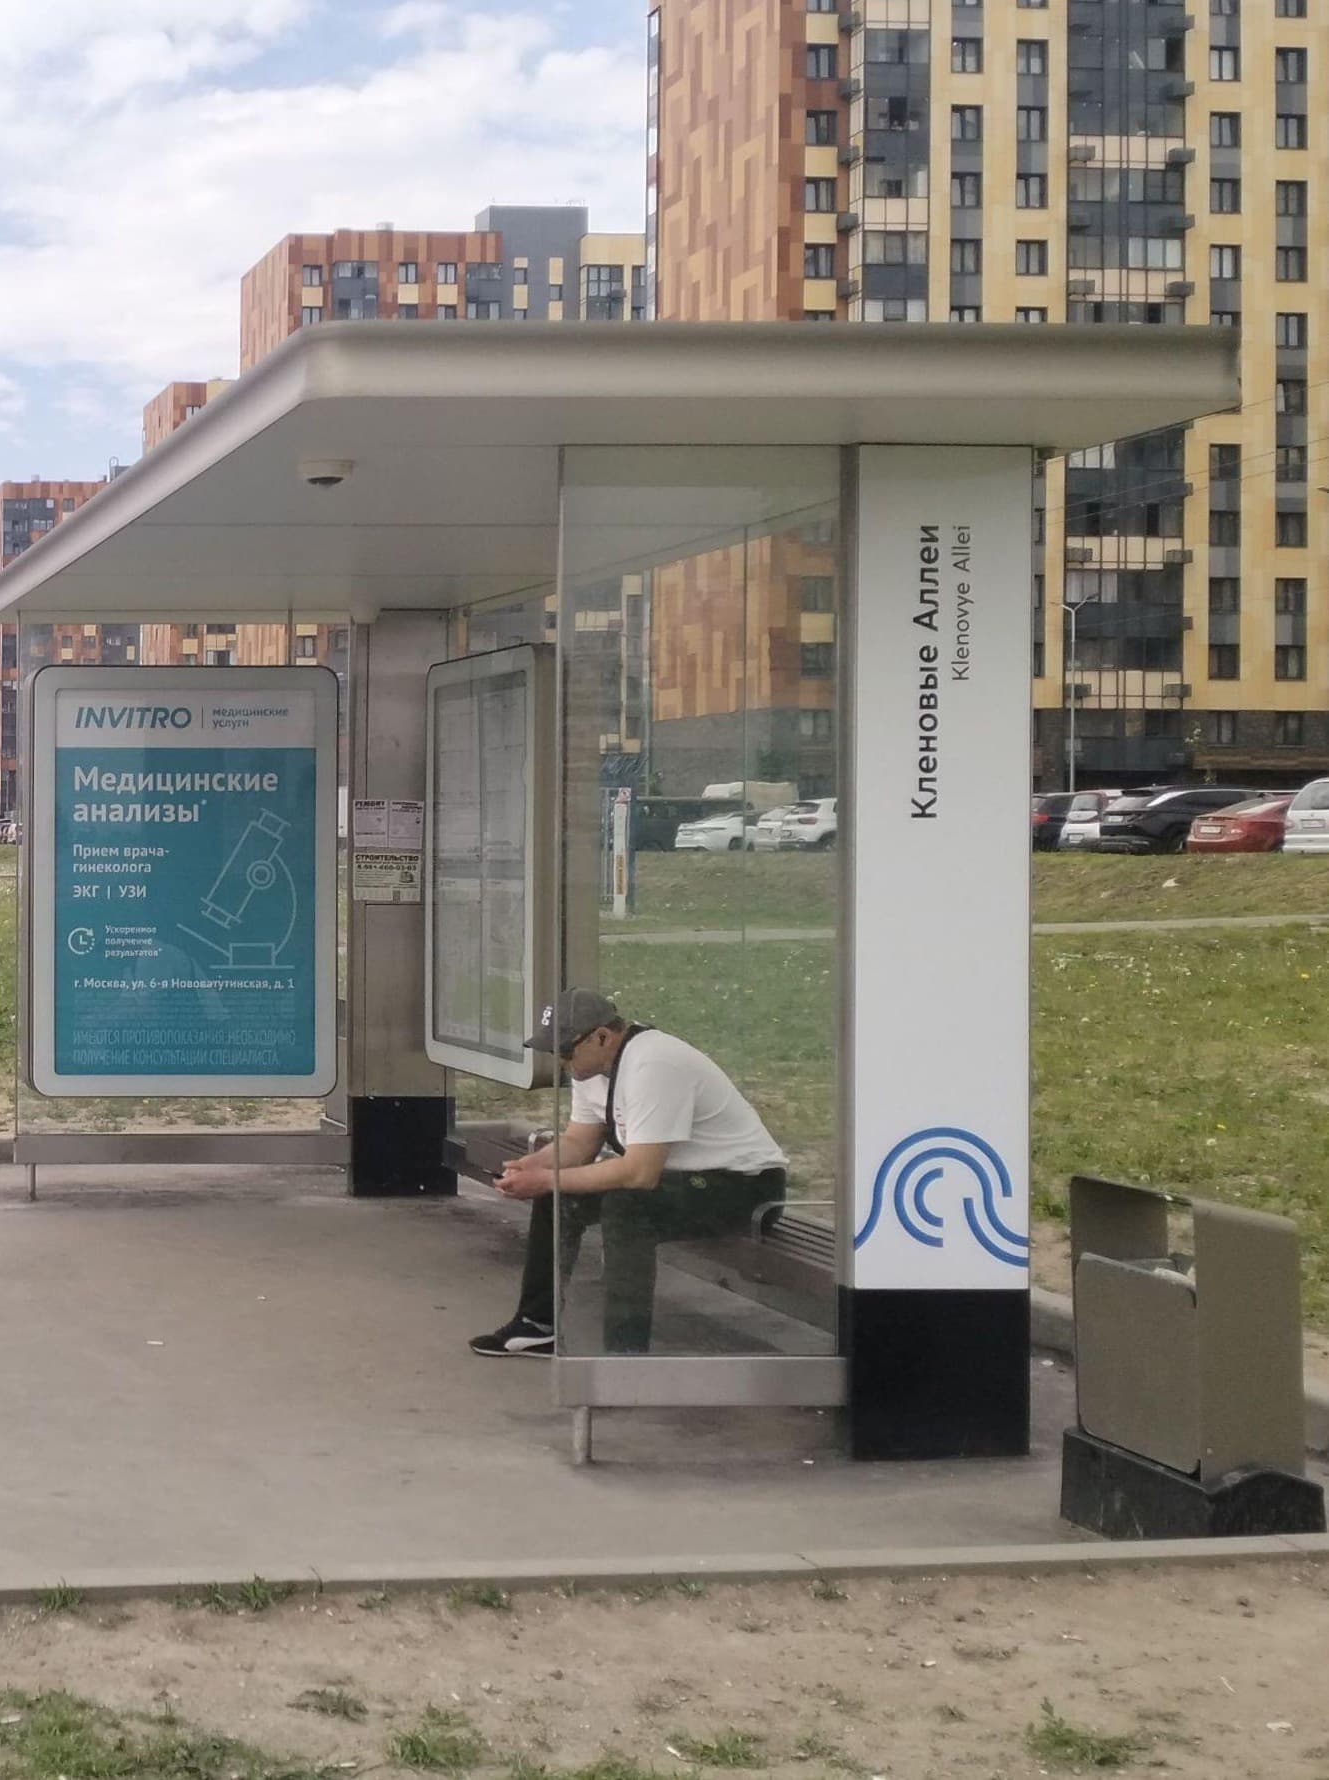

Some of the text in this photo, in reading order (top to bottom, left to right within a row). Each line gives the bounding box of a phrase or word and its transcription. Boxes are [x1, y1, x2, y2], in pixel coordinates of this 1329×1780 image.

[951, 525, 974, 681] Klenovye Allei
[911, 525, 940, 819] Кленовые Аллеи
[75, 707, 192, 729] INVITRO
[212, 707, 289, 718] медицинские
[212, 719, 249, 730] услуги
[73, 766, 279, 795] Медицинские
[73, 844, 169, 859] Прием врача-
[73, 863, 151, 873] гинеколога
[73, 885, 147, 898] ЭКГ УЗИ
[105, 937, 152, 947] получение
[84, 978, 129, 990] Москва,
[131, 979, 146, 990] ул.
[149, 978, 168, 989] 6-я
[288, 978, 295, 989] 1
